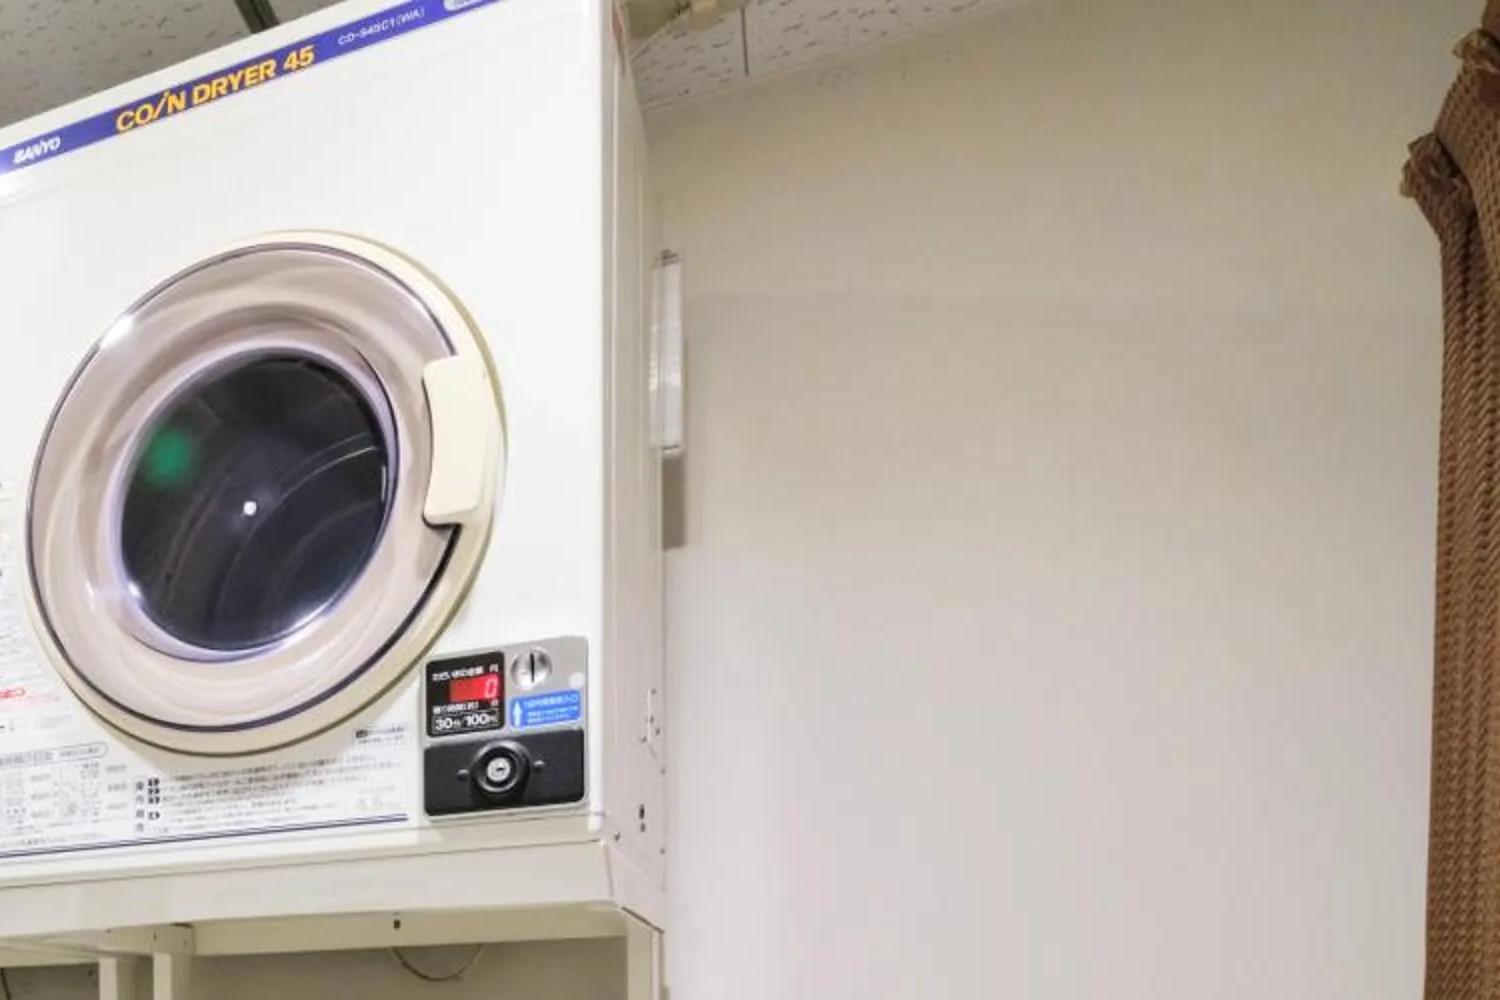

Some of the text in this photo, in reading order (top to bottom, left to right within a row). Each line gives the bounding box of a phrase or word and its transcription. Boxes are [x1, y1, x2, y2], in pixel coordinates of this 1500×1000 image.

[13, 137, 61, 163] SANYO
[192, 60, 276, 103] DRYER
[283, 45, 315, 72] 45
